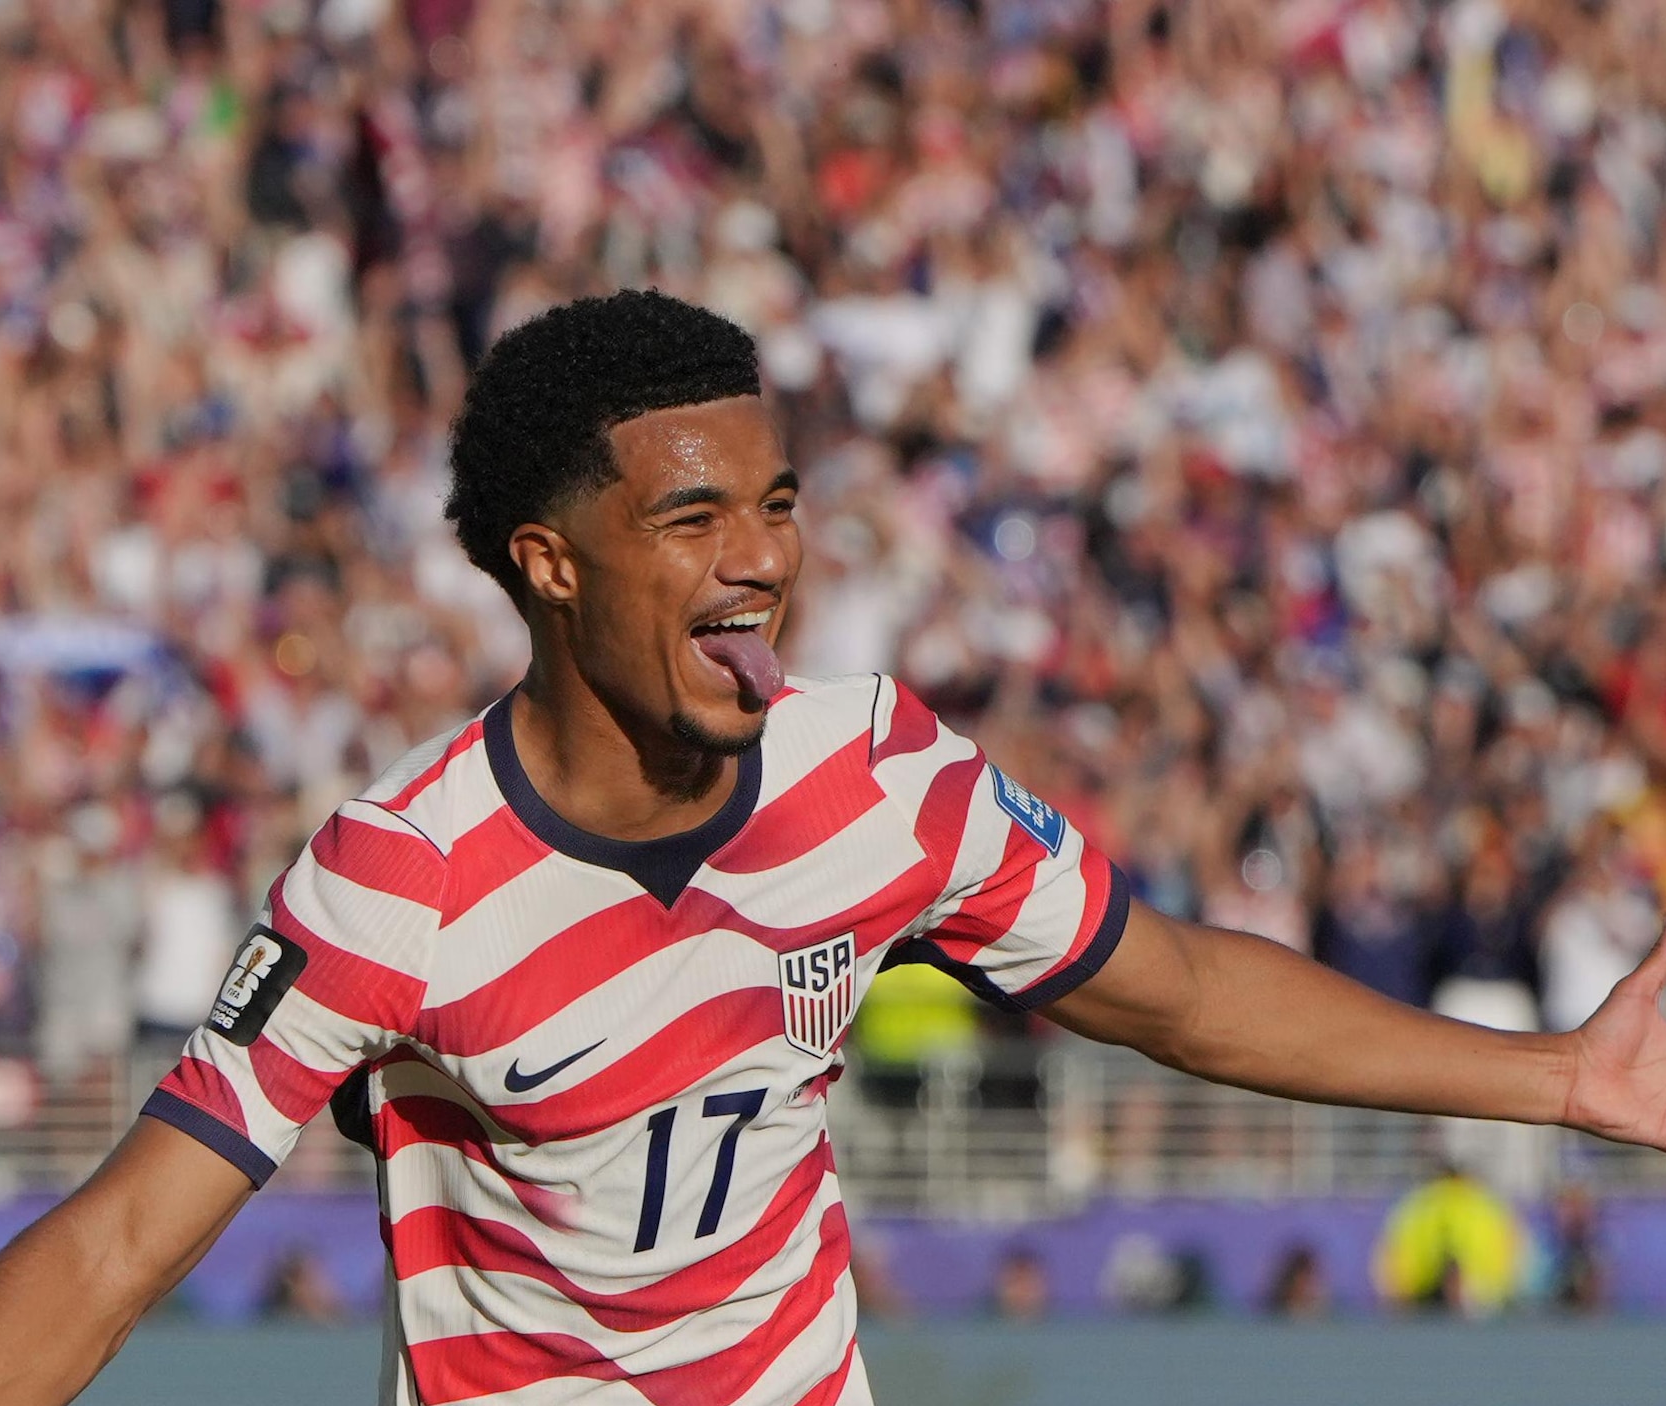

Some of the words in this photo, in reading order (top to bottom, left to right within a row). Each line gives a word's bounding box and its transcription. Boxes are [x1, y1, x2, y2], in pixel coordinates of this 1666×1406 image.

[786, 940, 849, 992] USA
[212, 1011, 234, 1029] 026
[633, 1087, 768, 1253] 17
